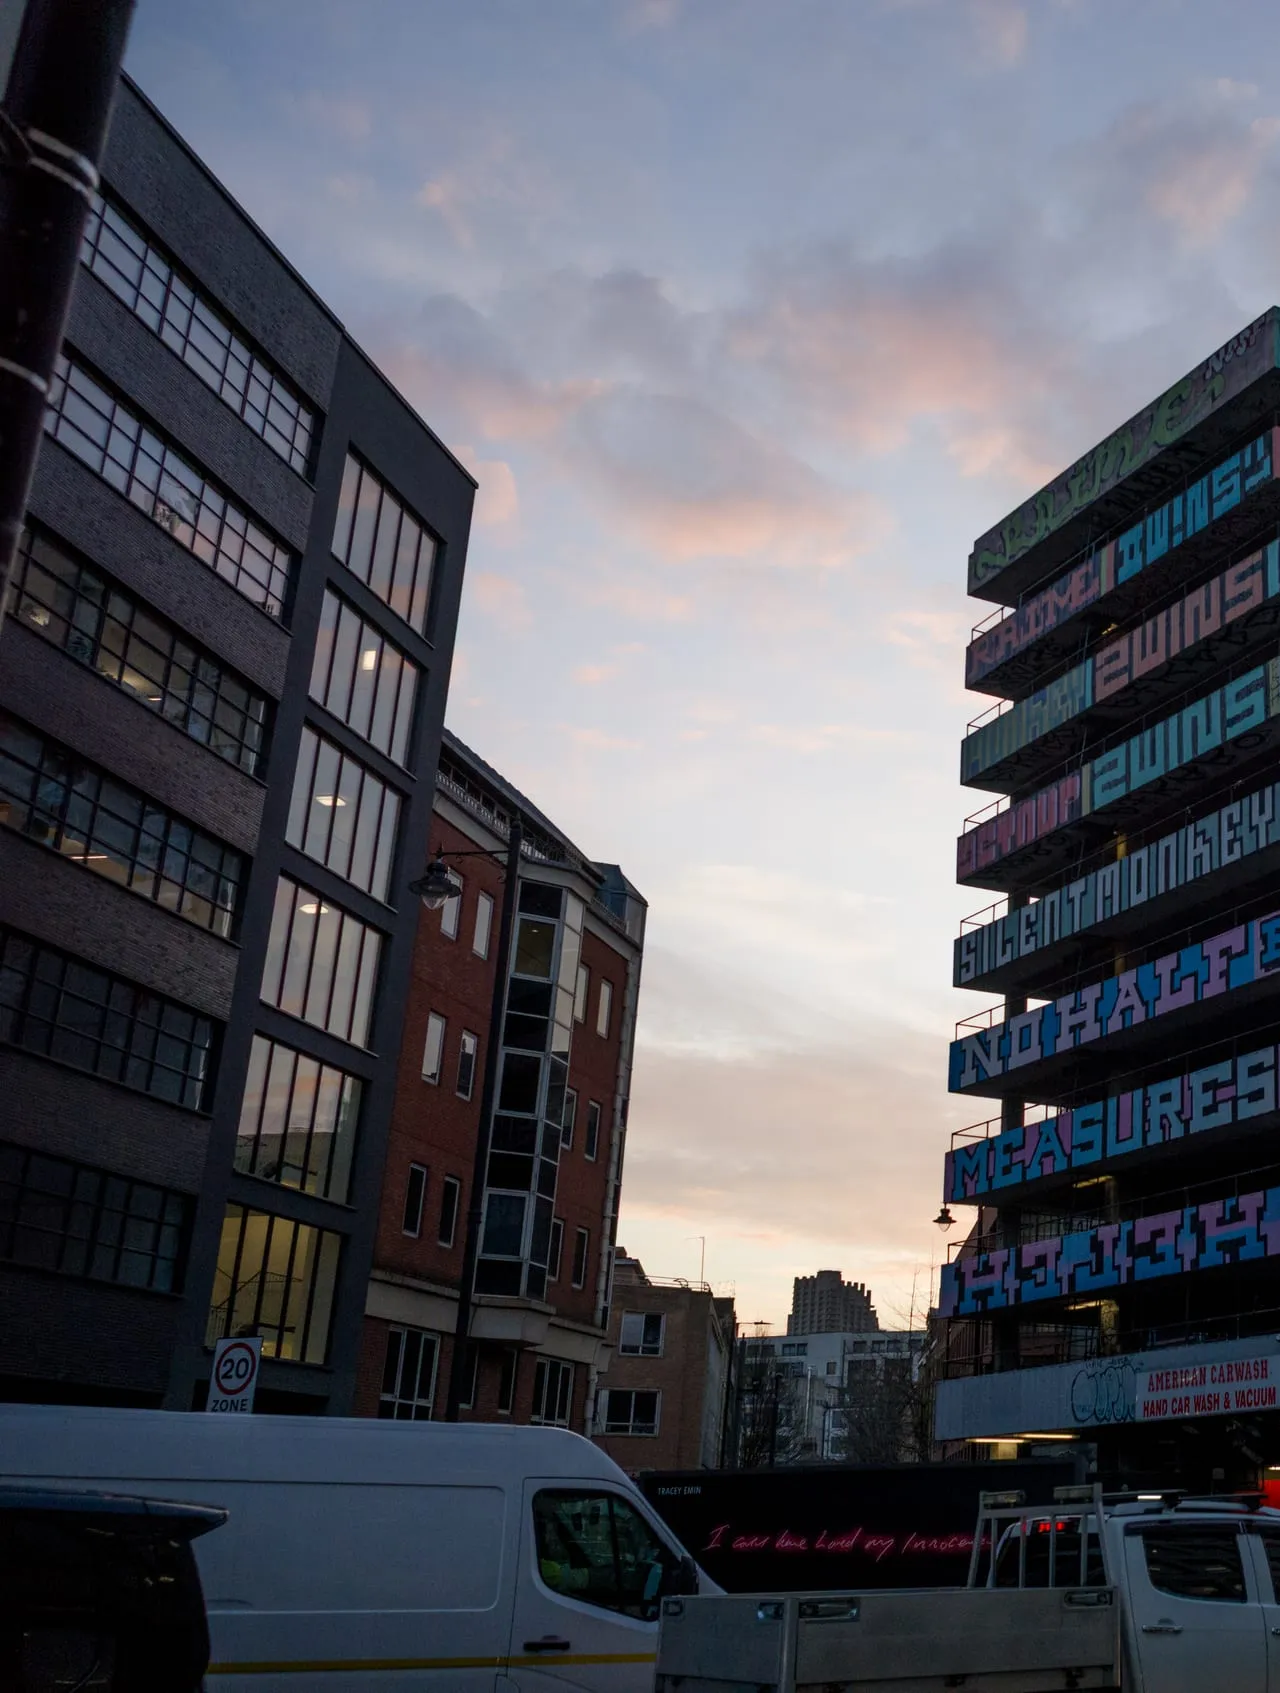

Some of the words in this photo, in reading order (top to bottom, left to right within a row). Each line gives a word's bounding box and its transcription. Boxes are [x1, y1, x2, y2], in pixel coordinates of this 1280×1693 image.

[960, 1010, 1045, 1087] NO
[1056, 924, 1247, 1040] HALF
[952, 1045, 1277, 1200] MEASURES
[221, 1358, 250, 1379] 20
[1148, 1366, 1206, 1392] AMERICAN
[1210, 1359, 1268, 1384] CARWASH
[211, 1399, 248, 1412] ZONE
[1143, 1399, 1168, 1417] HAND
[1171, 1396, 1190, 1414] CAR
[1193, 1392, 1220, 1413] WASH
[1223, 1392, 1231, 1410] &
[1235, 1387, 1277, 1408] VACUUM
[657, 1487, 682, 1495] TRACEY
